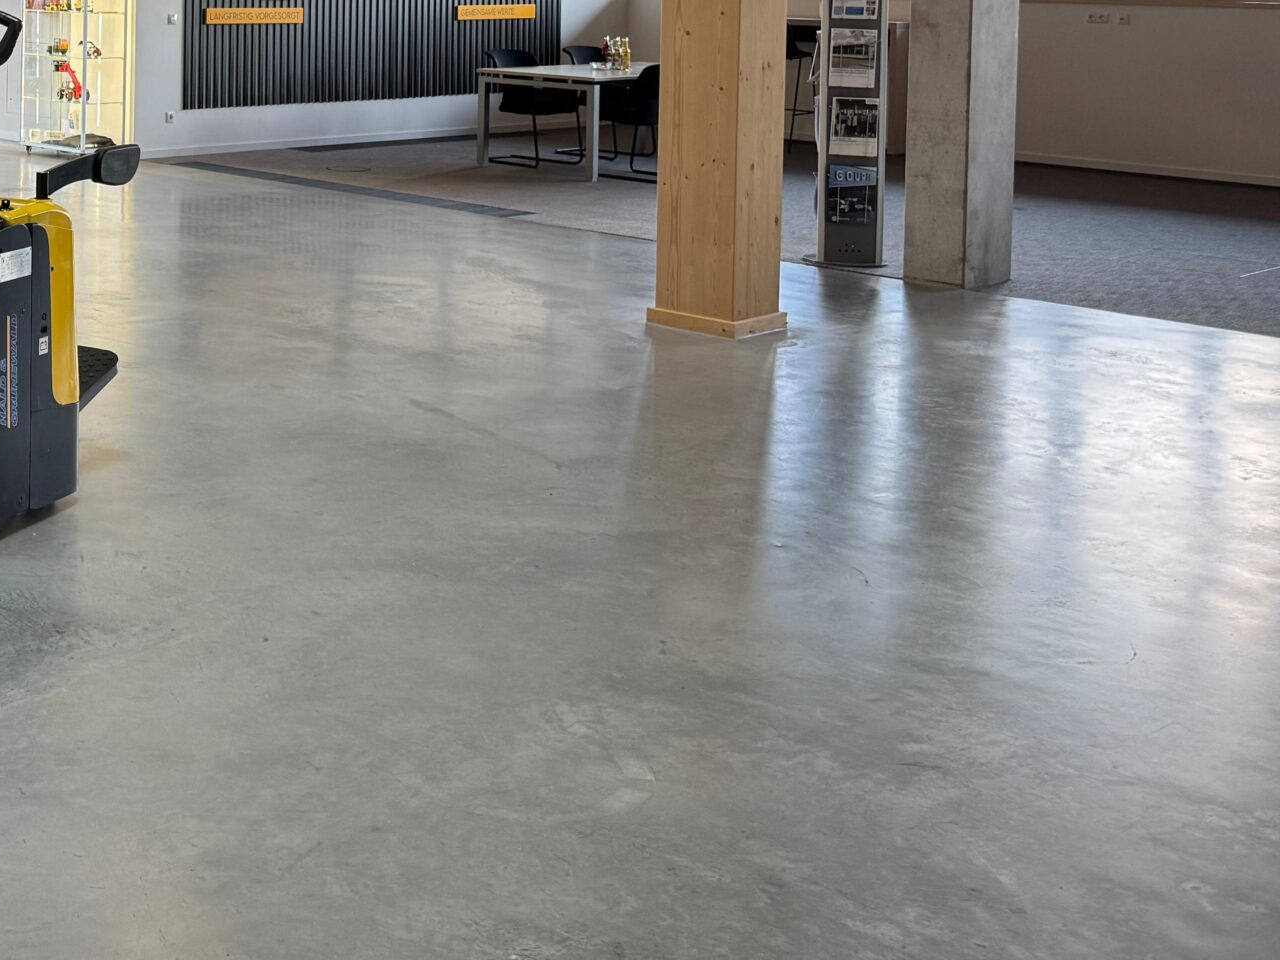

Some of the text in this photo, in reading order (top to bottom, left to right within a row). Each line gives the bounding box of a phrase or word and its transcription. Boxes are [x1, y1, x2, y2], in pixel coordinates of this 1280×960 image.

[209, 11, 300, 21] LANGFRISTIG VORGESORGT
[0, 358, 7, 373] &
[11, 313, 19, 428] GRUNEWALD
